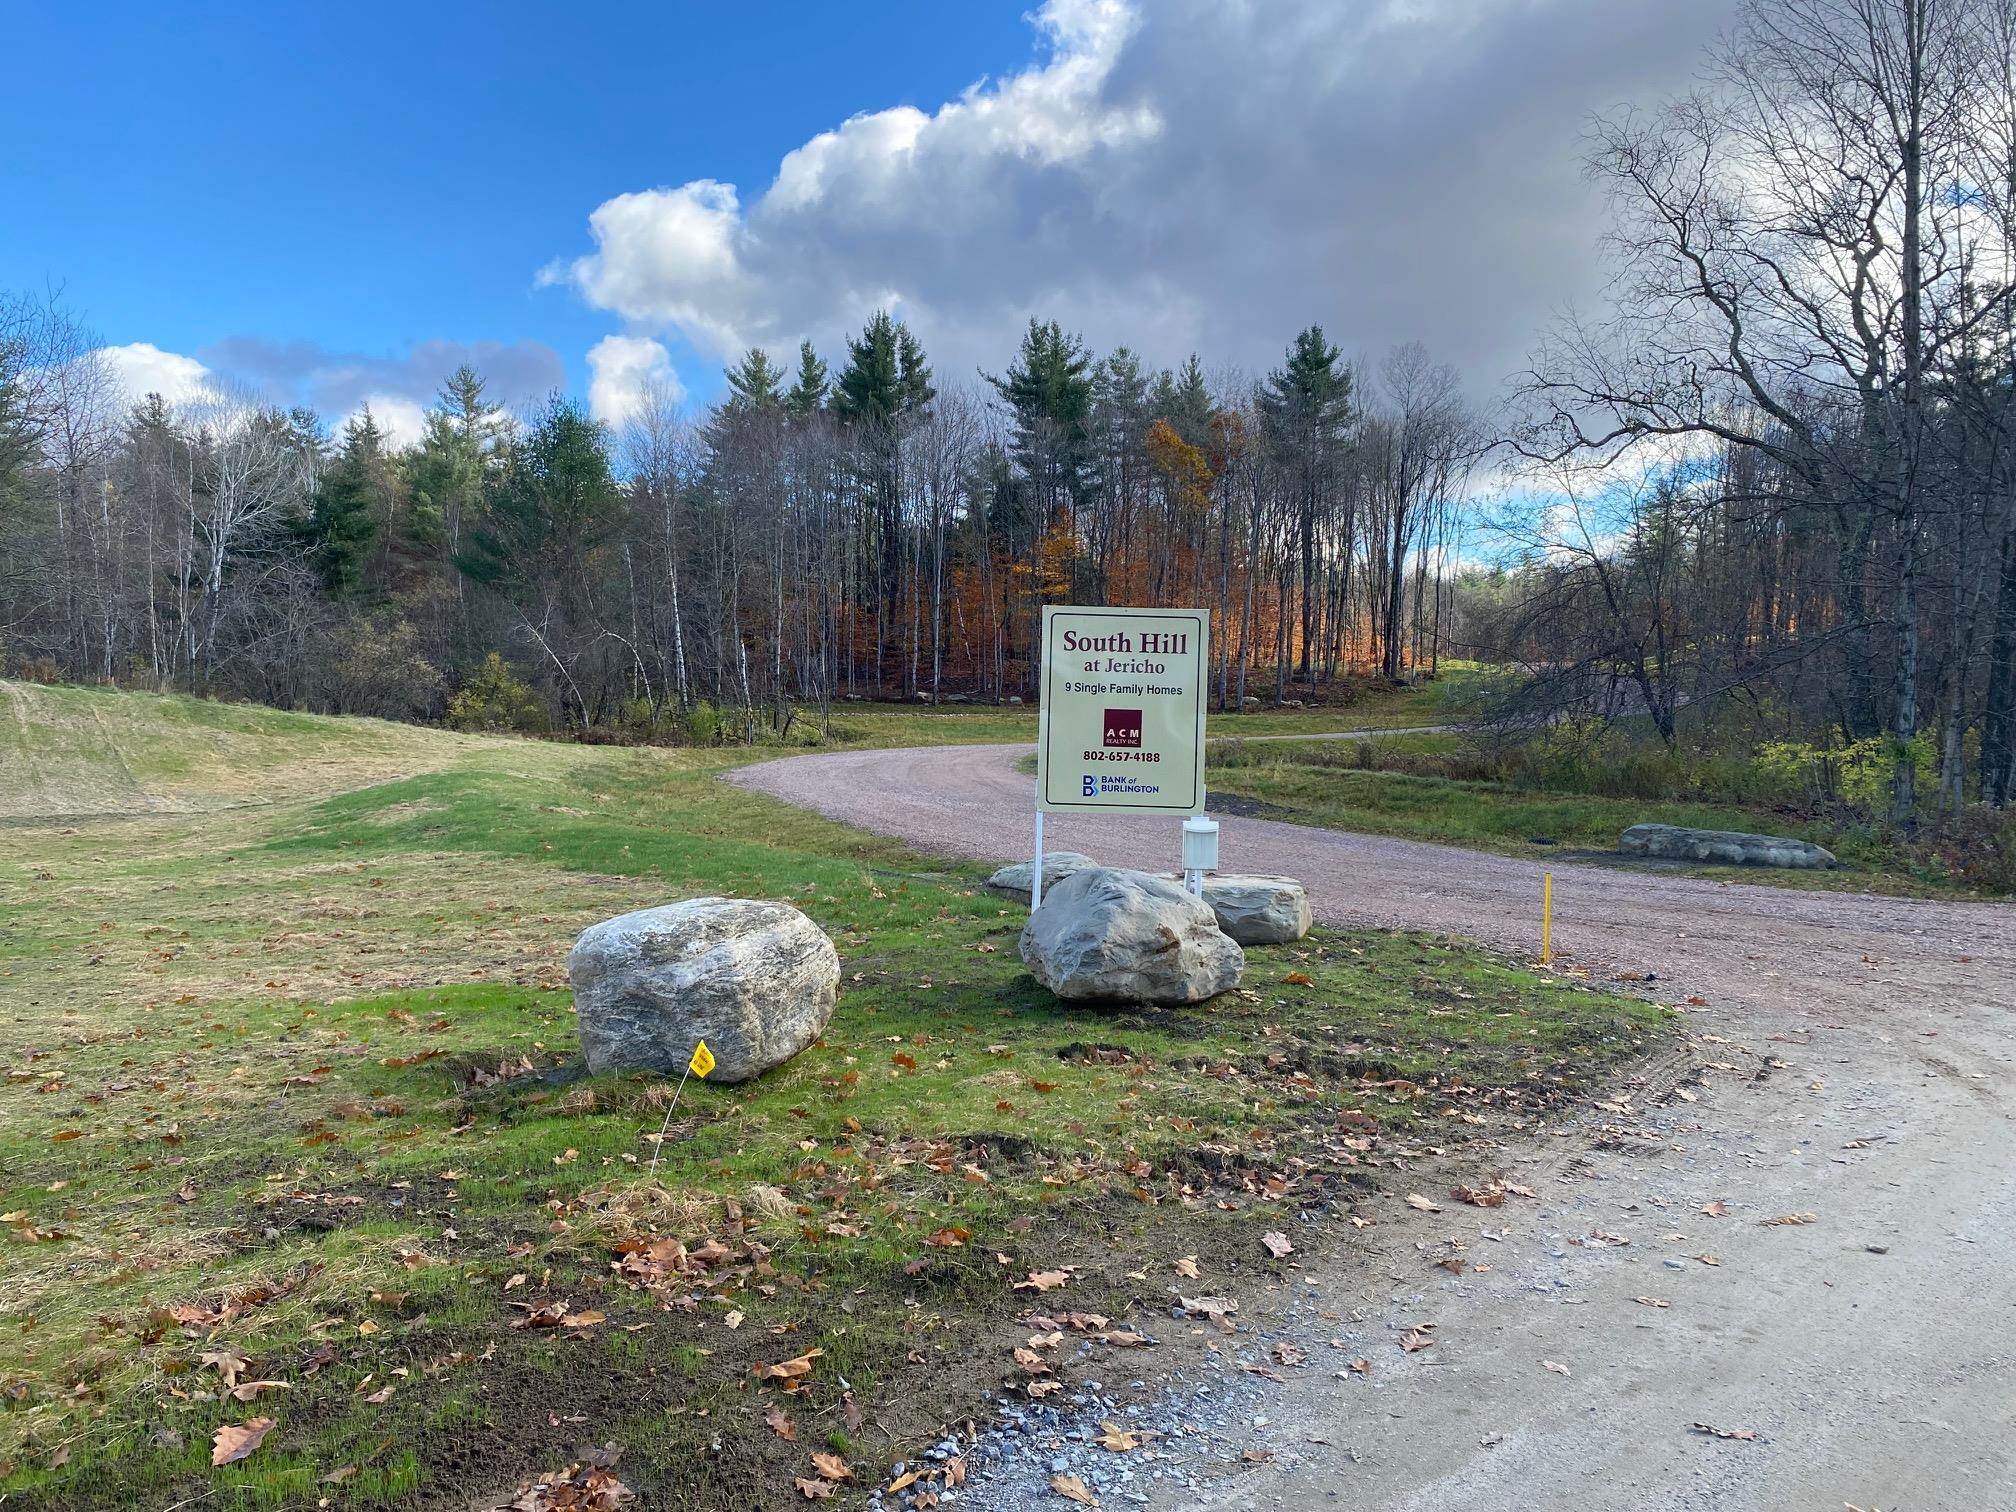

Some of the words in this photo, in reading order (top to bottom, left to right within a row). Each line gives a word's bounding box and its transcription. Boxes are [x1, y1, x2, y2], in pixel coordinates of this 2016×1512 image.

[1063, 630, 1132, 653] South
[1139, 632, 1188, 655] Hill
[1084, 659, 1100, 672] at
[1105, 658, 1165, 674] Jericho
[1065, 682, 1072, 692] 9
[1074, 683, 1107, 695] Single
[1109, 683, 1143, 696] Family
[1147, 684, 1183, 695] Homes
[1083, 751, 1160, 762] 802-657-4188
[1101, 775, 1127, 784] BANK
[1101, 785, 1159, 793] BURLINGTON
